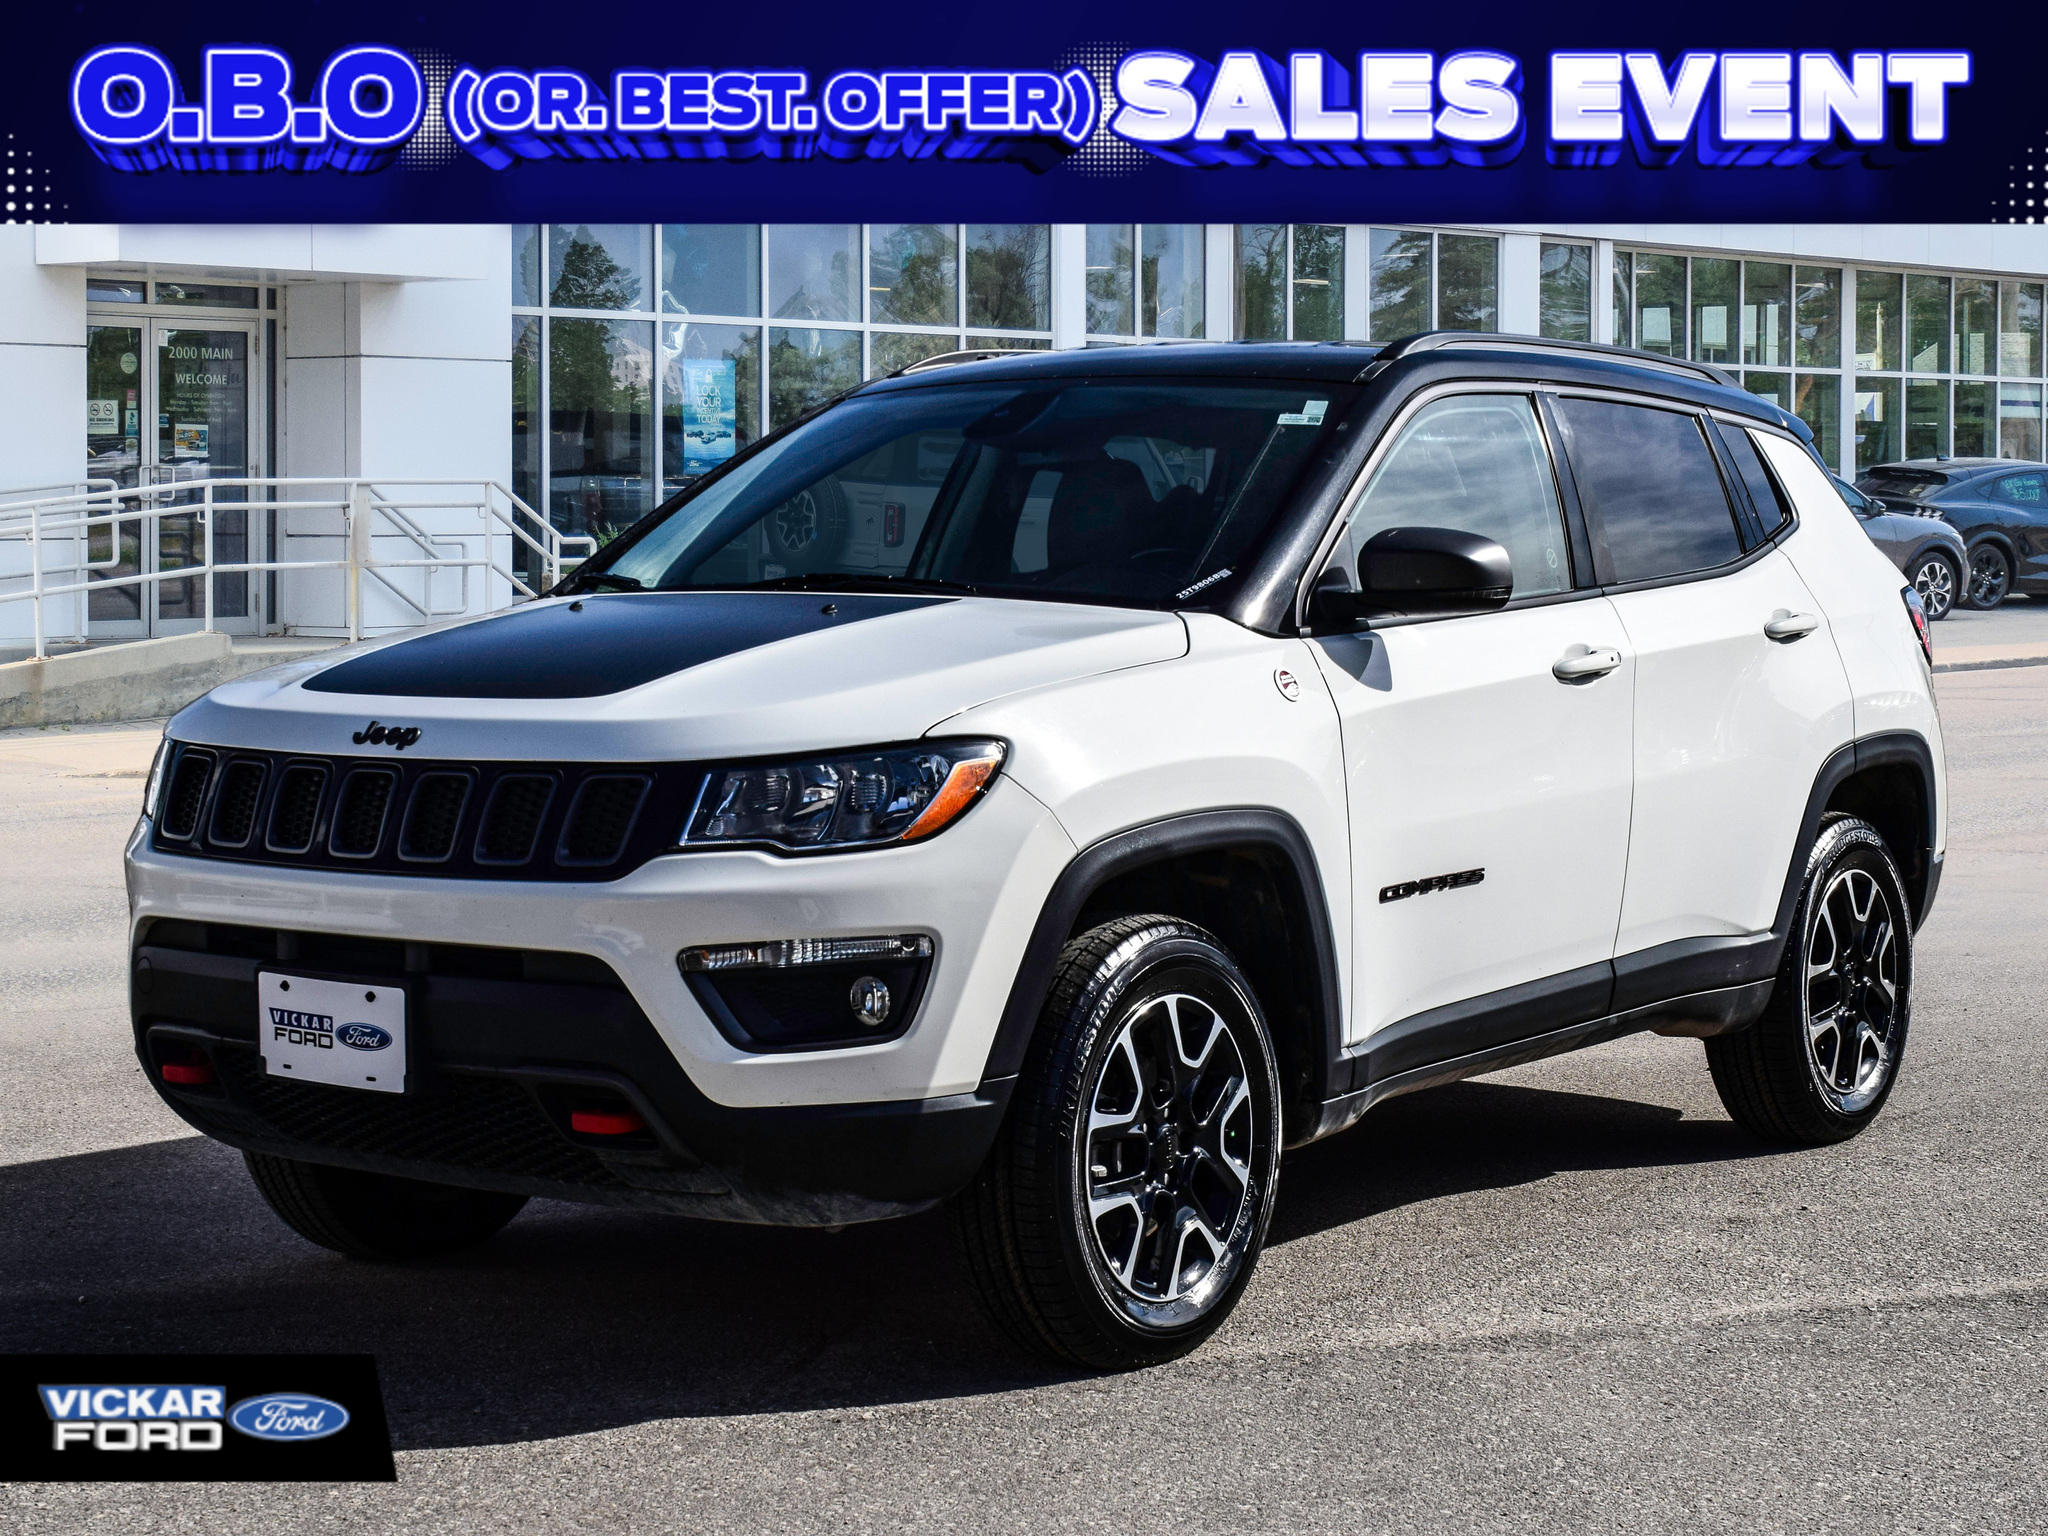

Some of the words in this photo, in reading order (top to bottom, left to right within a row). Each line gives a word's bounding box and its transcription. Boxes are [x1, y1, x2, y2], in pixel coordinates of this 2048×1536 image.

[168, 346, 198, 359] 2000
[201, 347, 233, 359] MAIN
[175, 373, 228, 385] WELCOME
[696, 385, 721, 396] LOCK
[696, 396, 722, 407] YOUR
[696, 414, 721, 424] TODAY
[352, 720, 421, 751] Jeep
[1379, 867, 1485, 904] COMPASS
[272, 1009, 332, 1031] VICKAR
[274, 1026, 333, 1049] FORD
[345, 1025, 381, 1047] Ford
